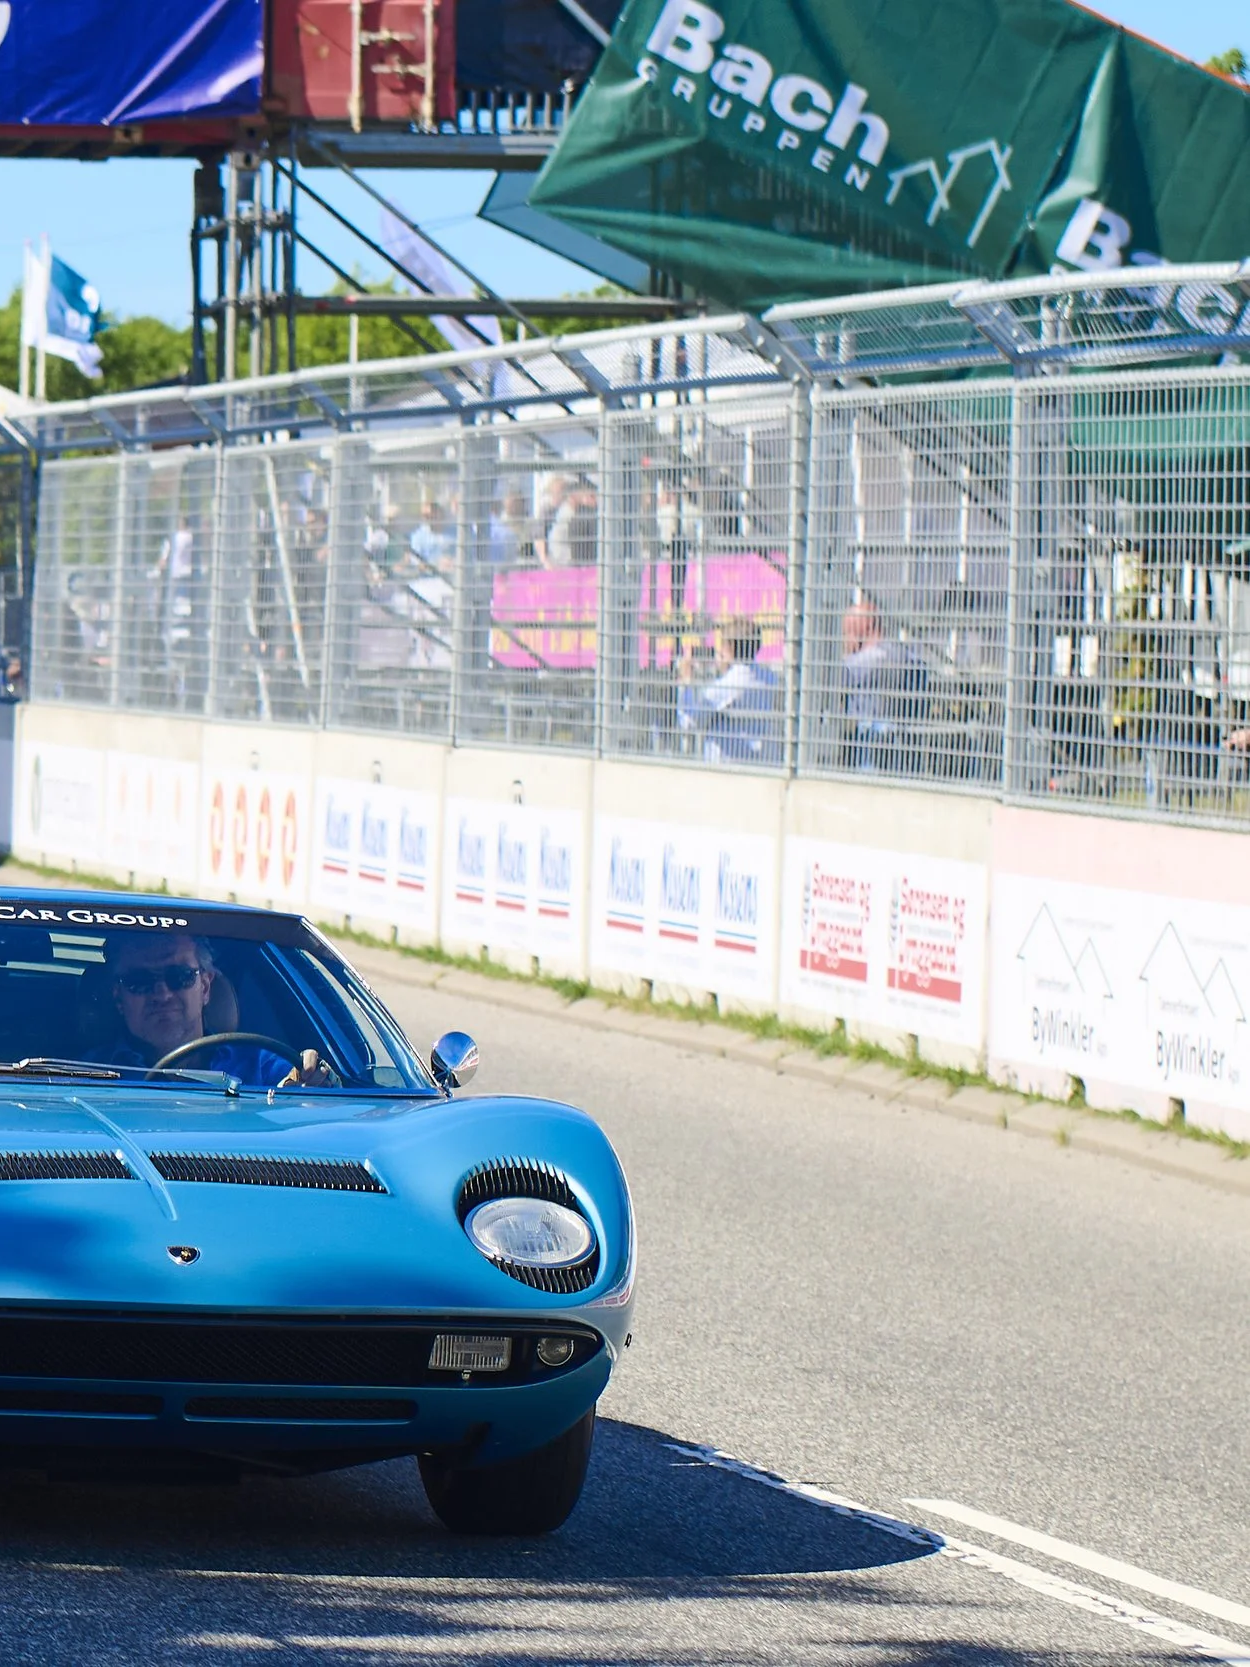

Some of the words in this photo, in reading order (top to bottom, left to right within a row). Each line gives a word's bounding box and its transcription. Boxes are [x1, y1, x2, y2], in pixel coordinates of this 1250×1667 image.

[636, 56, 871, 193] GRUPPEN
[645, 0, 890, 167] Bach
[1031, 1005, 1095, 1055] ByWinkler
[1155, 1029, 1226, 1081] ByWinkler
